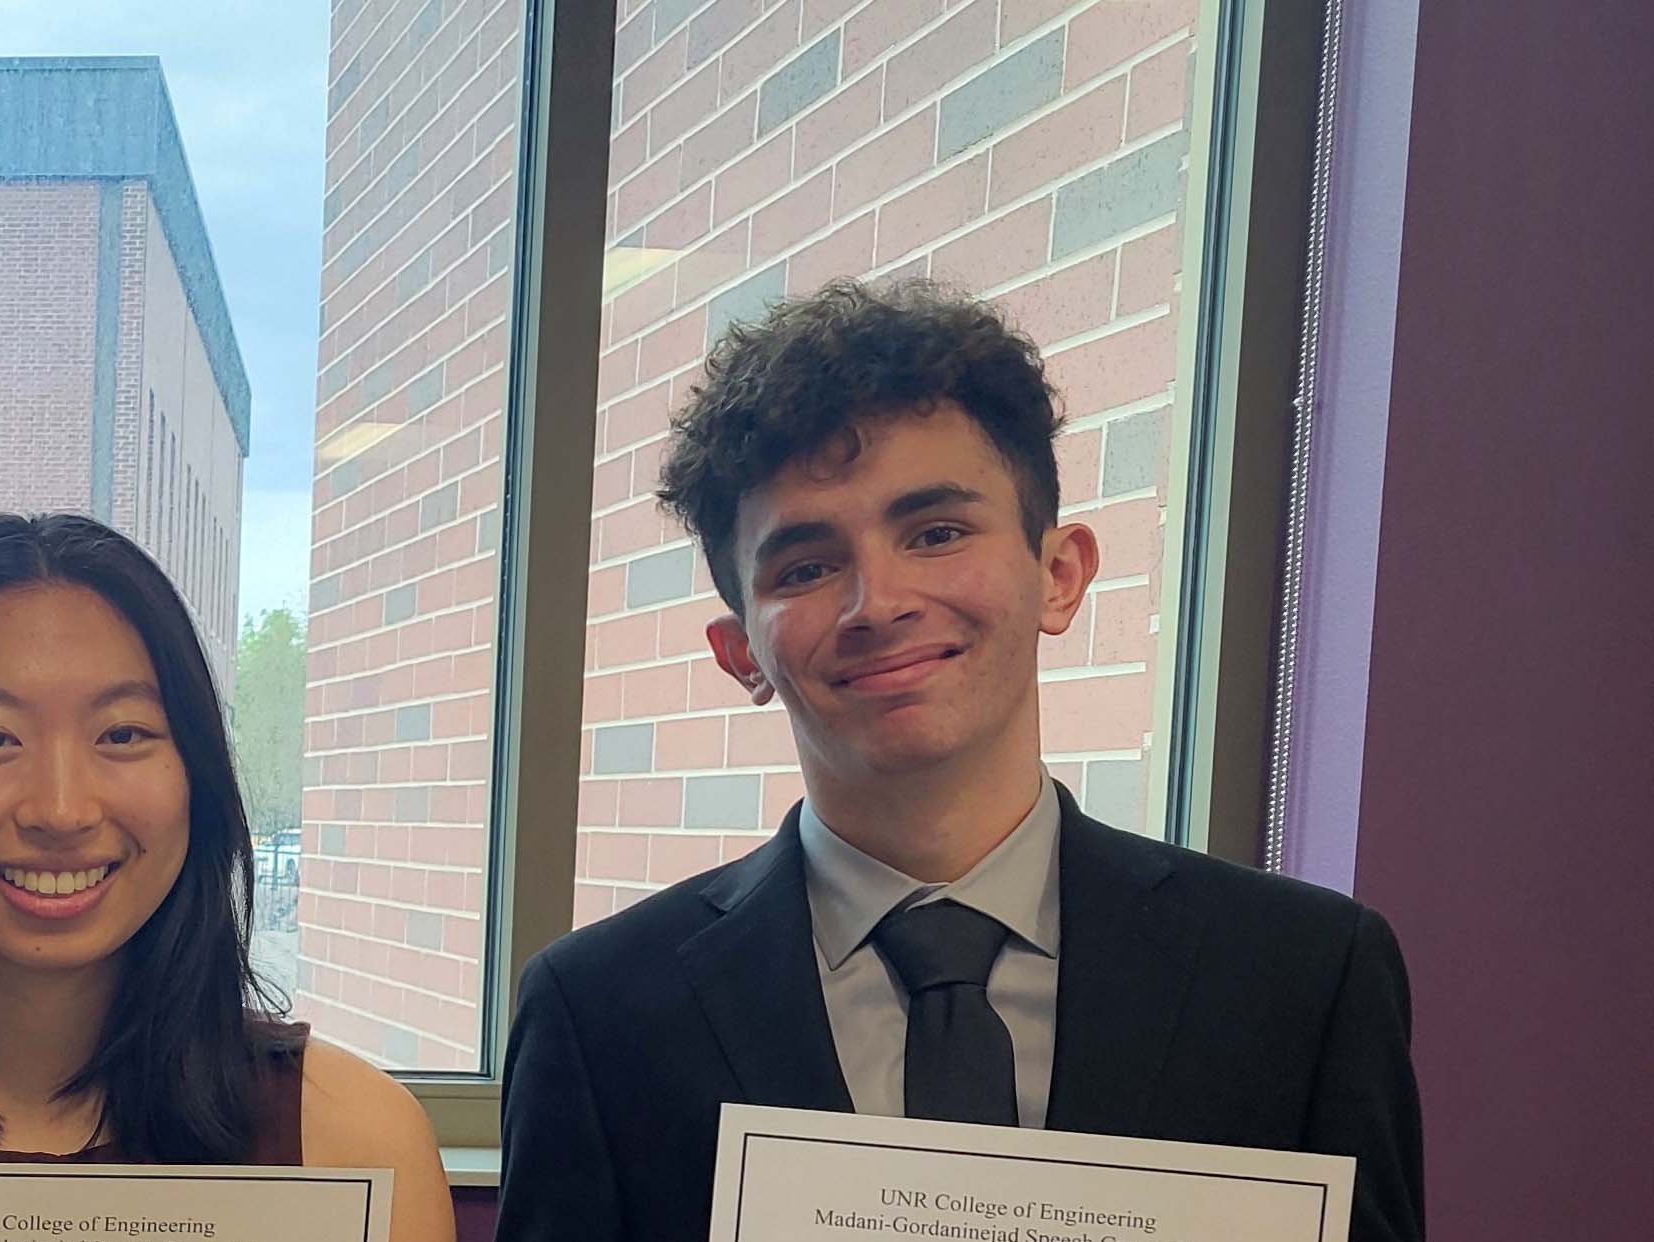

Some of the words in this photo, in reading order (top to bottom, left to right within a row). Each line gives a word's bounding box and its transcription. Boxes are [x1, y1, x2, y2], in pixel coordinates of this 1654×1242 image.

[2, 1215, 74, 1235] College
[79, 1215, 101, 1234] of
[104, 1216, 216, 1238] Engineering
[880, 1188, 928, 1209] UNR
[934, 1194, 1009, 1220] College
[1013, 1201, 1037, 1219] of
[1040, 1202, 1157, 1232] Engineering
